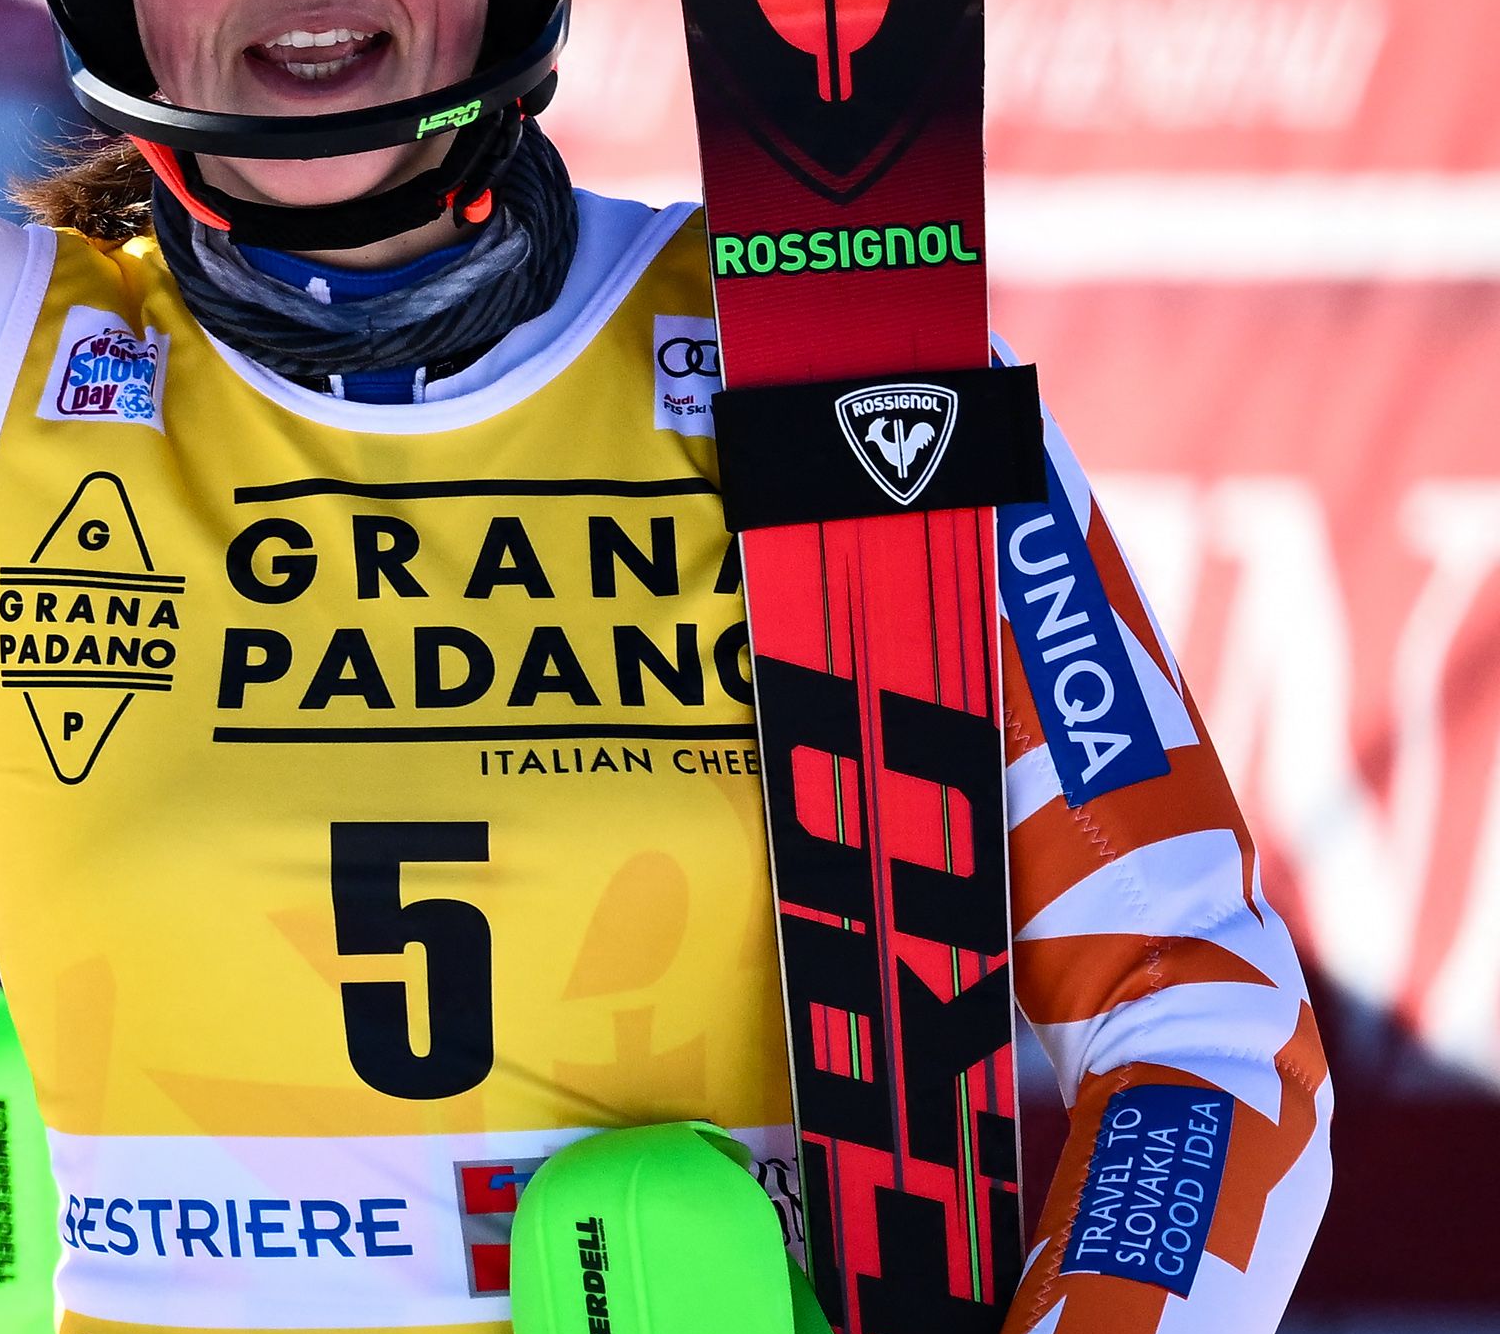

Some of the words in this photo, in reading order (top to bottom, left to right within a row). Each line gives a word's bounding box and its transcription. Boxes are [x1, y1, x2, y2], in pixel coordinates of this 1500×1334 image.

[716, 223, 979, 276] ROSSIGNOL
[69, 352, 155, 387] Snow
[71, 384, 118, 410] Day
[686, 404, 707, 415] Ski
[851, 395, 943, 415] ROSSIGNOL
[78, 519, 111, 550] G
[0, 633, 177, 669] PADANO
[1008, 512, 1131, 785] UNIQA
[62, 711, 84, 741] P
[480, 748, 654, 777] ITALIAN
[673, 750, 758, 777] CHEE
[330, 822, 494, 1101] 5
[1076, 1139, 1132, 1262] TRAVEL
[1108, 1104, 1143, 1138] TO
[1117, 1126, 1178, 1268] SLOVAKIA
[1153, 1178, 1205, 1279] GOOD
[1190, 1099, 1223, 1173] IDEA
[65, 1199, 414, 1259] SESTRIERE
